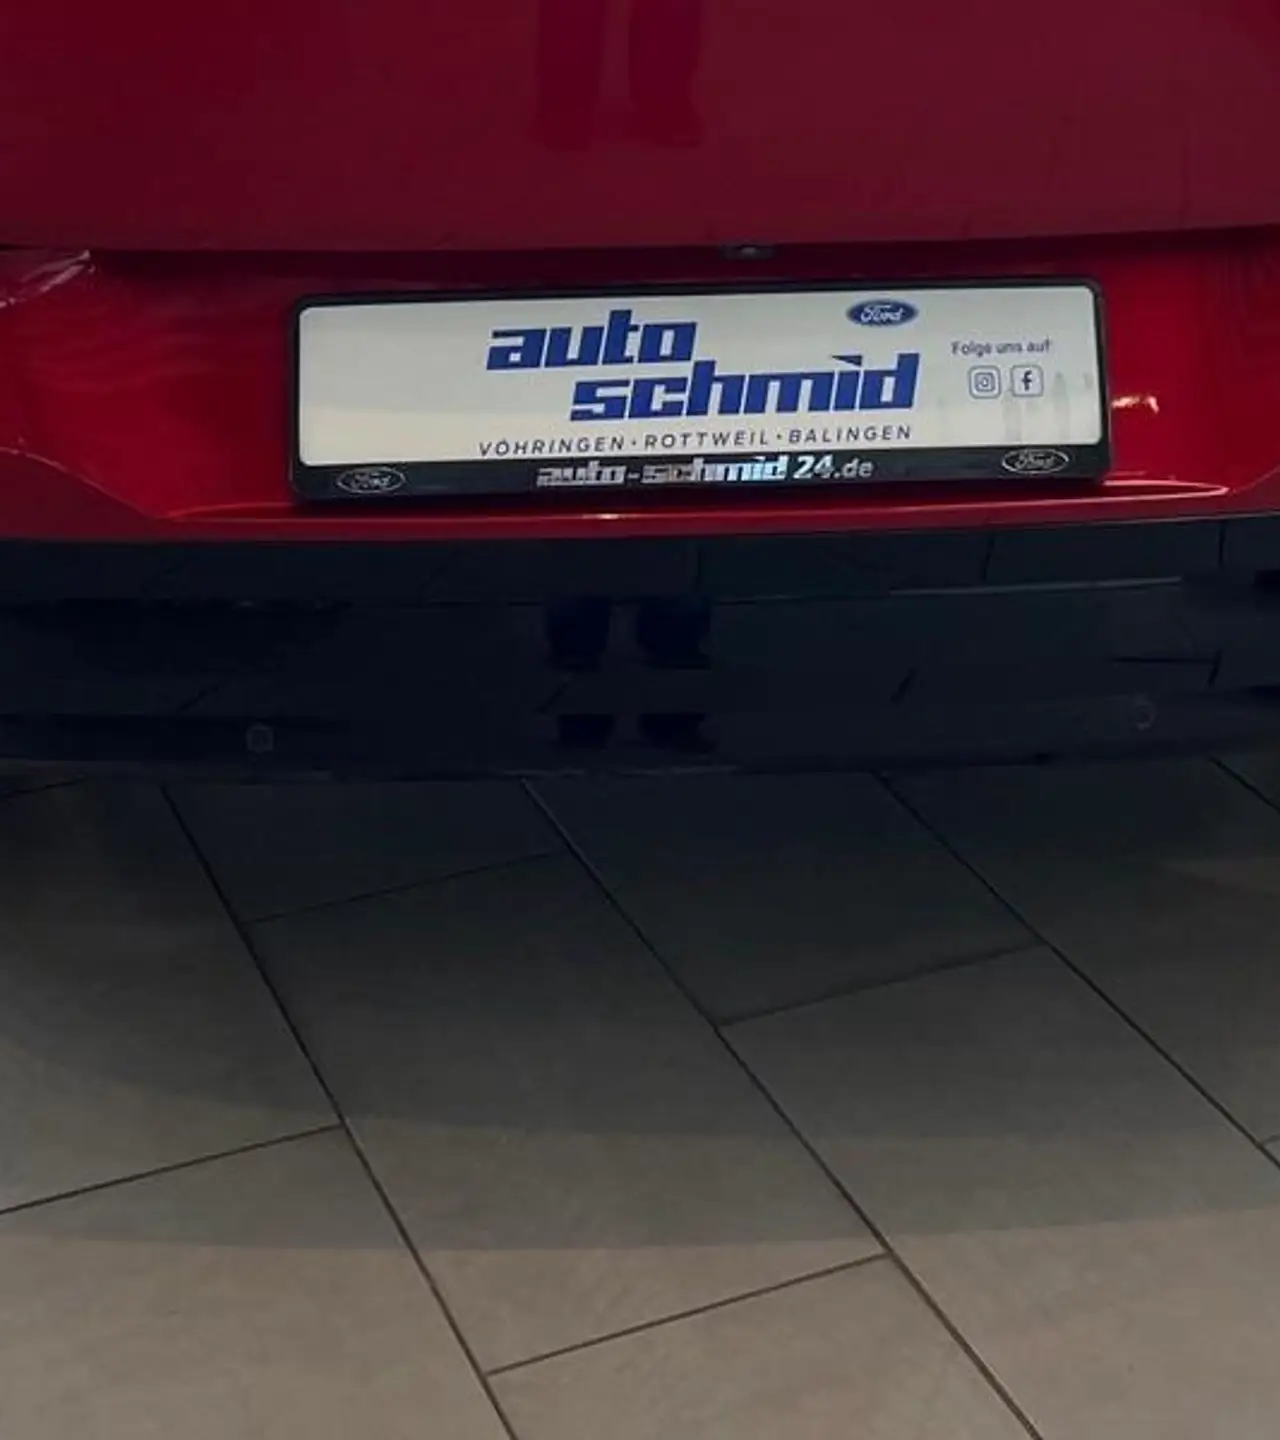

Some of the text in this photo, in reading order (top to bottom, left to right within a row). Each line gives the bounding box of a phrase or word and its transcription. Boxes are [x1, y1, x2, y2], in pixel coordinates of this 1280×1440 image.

[859, 304, 905, 323] Ford
[486, 309, 698, 371] auto
[951, 340, 992, 358] Folge
[570, 352, 921, 422] schmid
[644, 431, 770, 450] ROTTWEIL
[788, 424, 913, 444] BALINGEN
